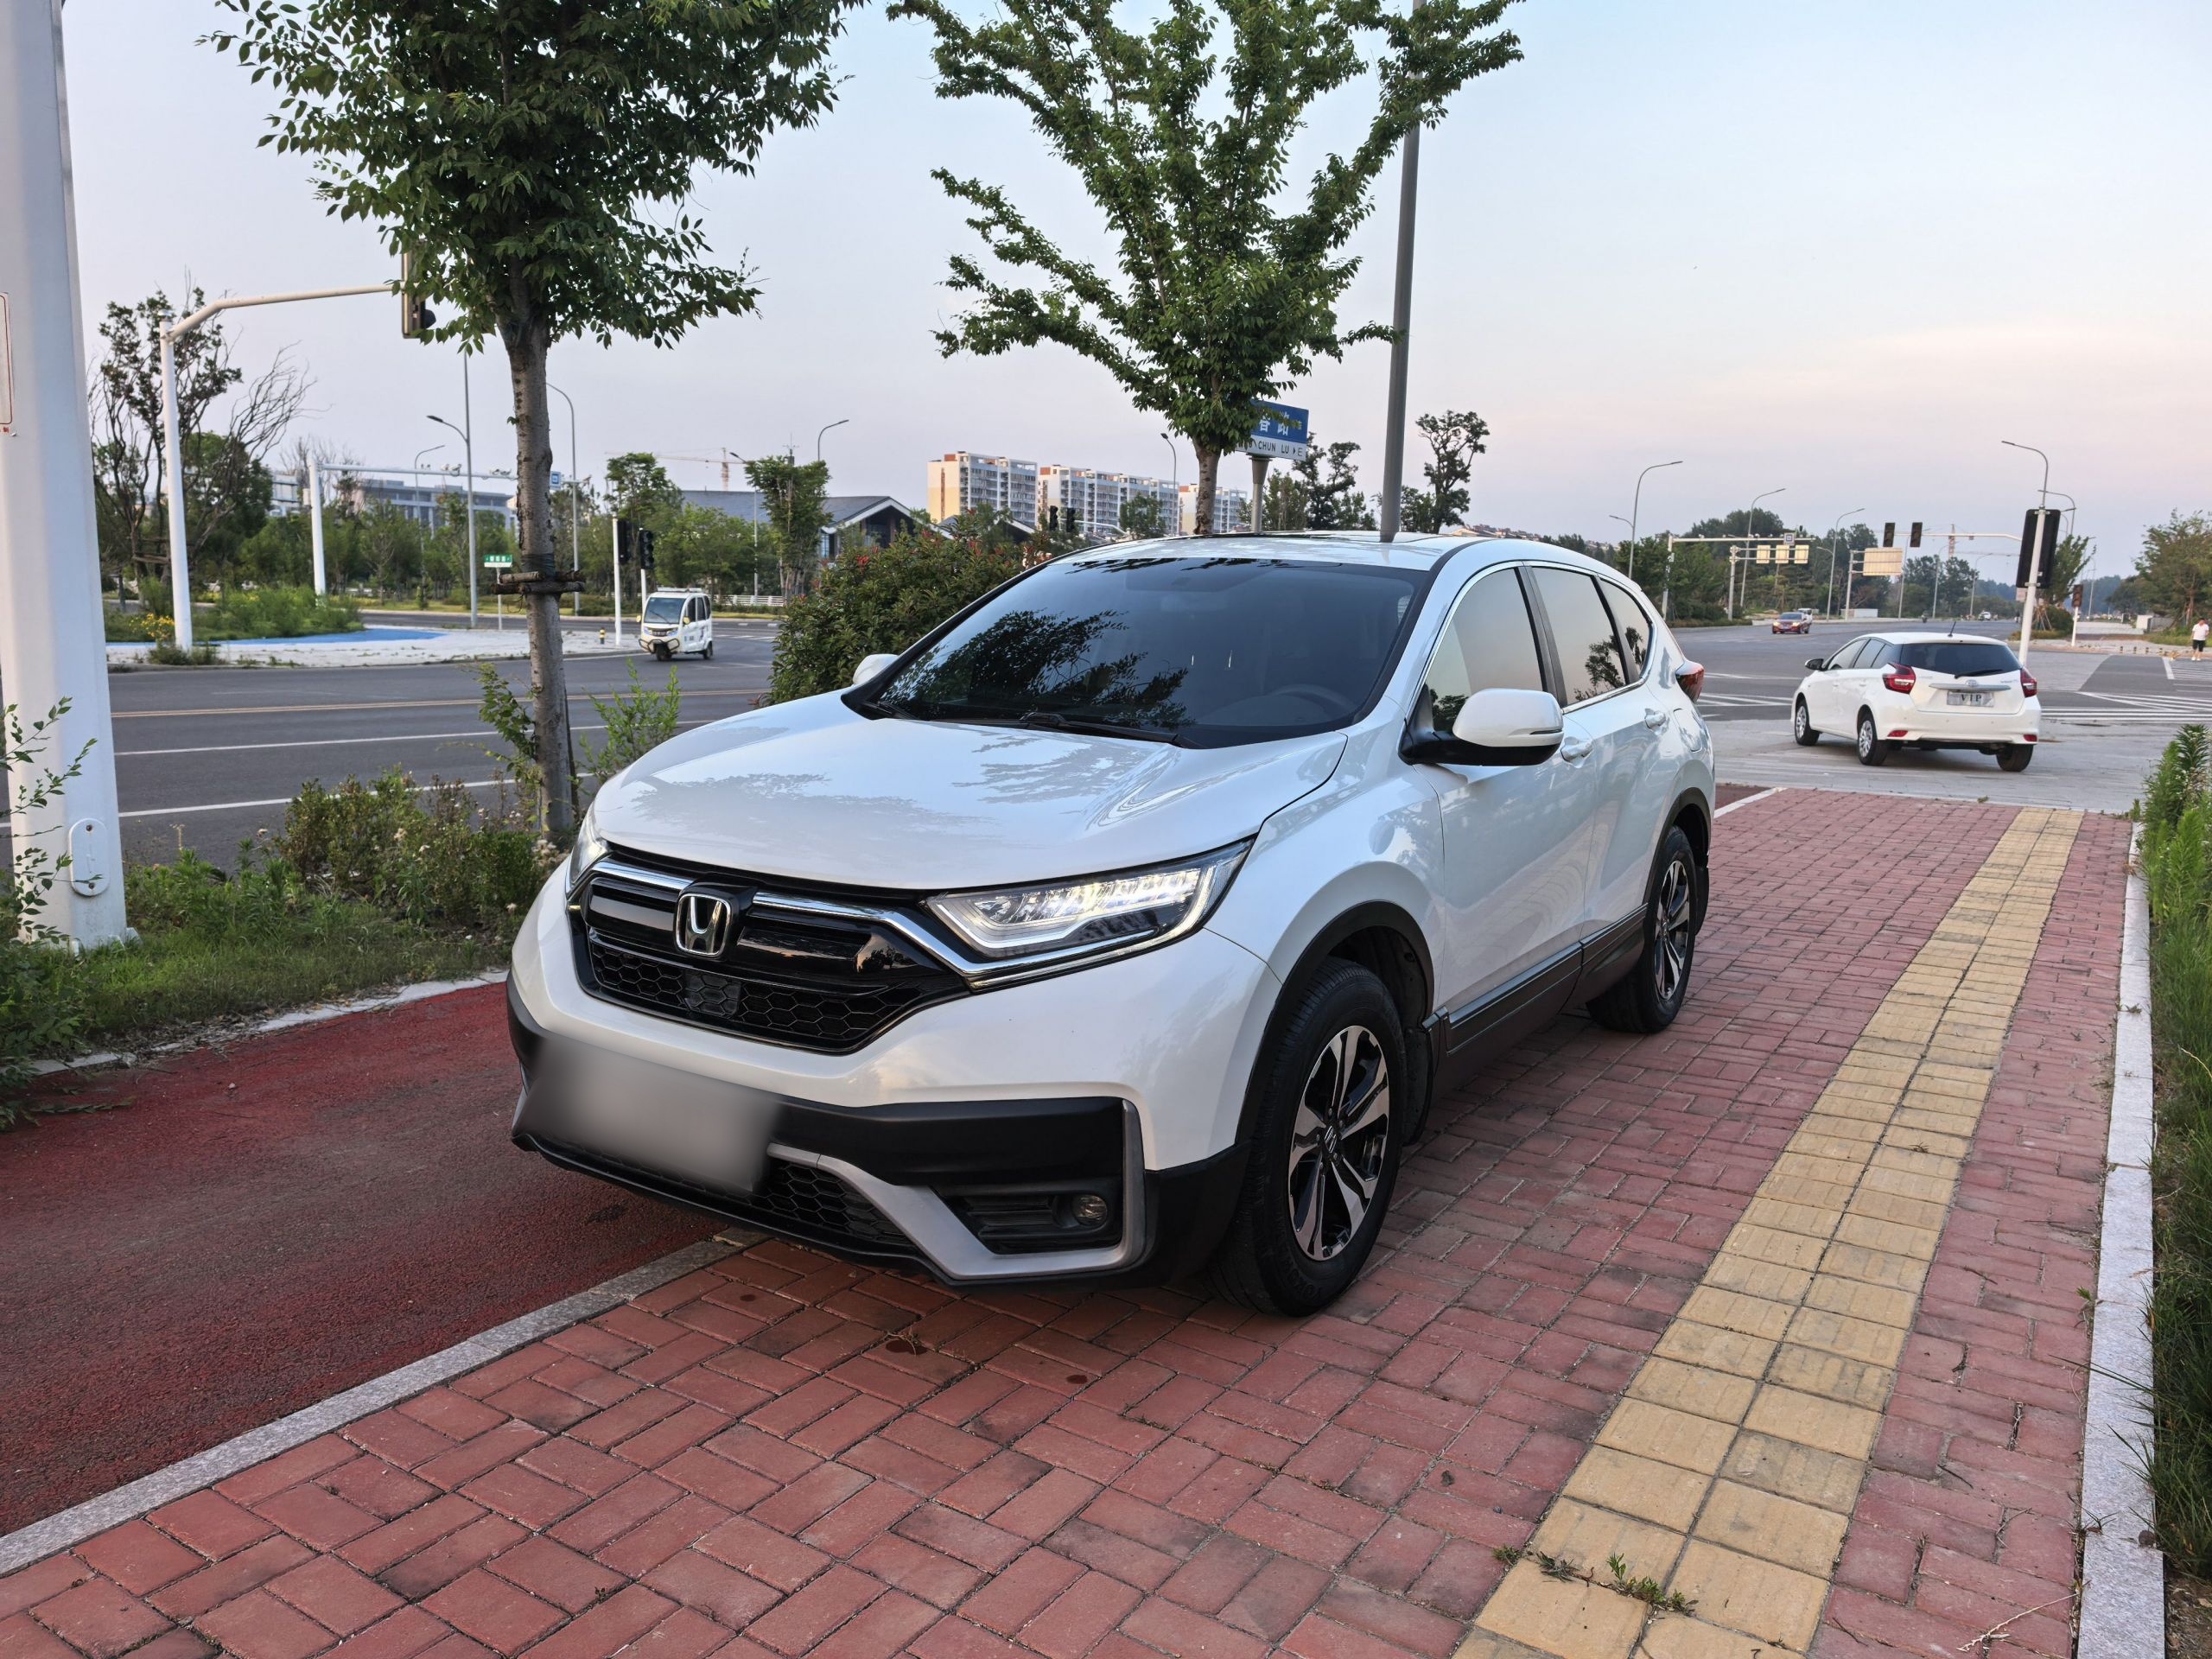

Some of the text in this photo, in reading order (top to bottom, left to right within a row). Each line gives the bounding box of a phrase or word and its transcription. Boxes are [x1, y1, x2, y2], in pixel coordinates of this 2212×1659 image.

[1258, 441, 1276, 452] CHUN
[1281, 444, 1290, 454] LU
[1961, 694, 1982, 702] VIP
